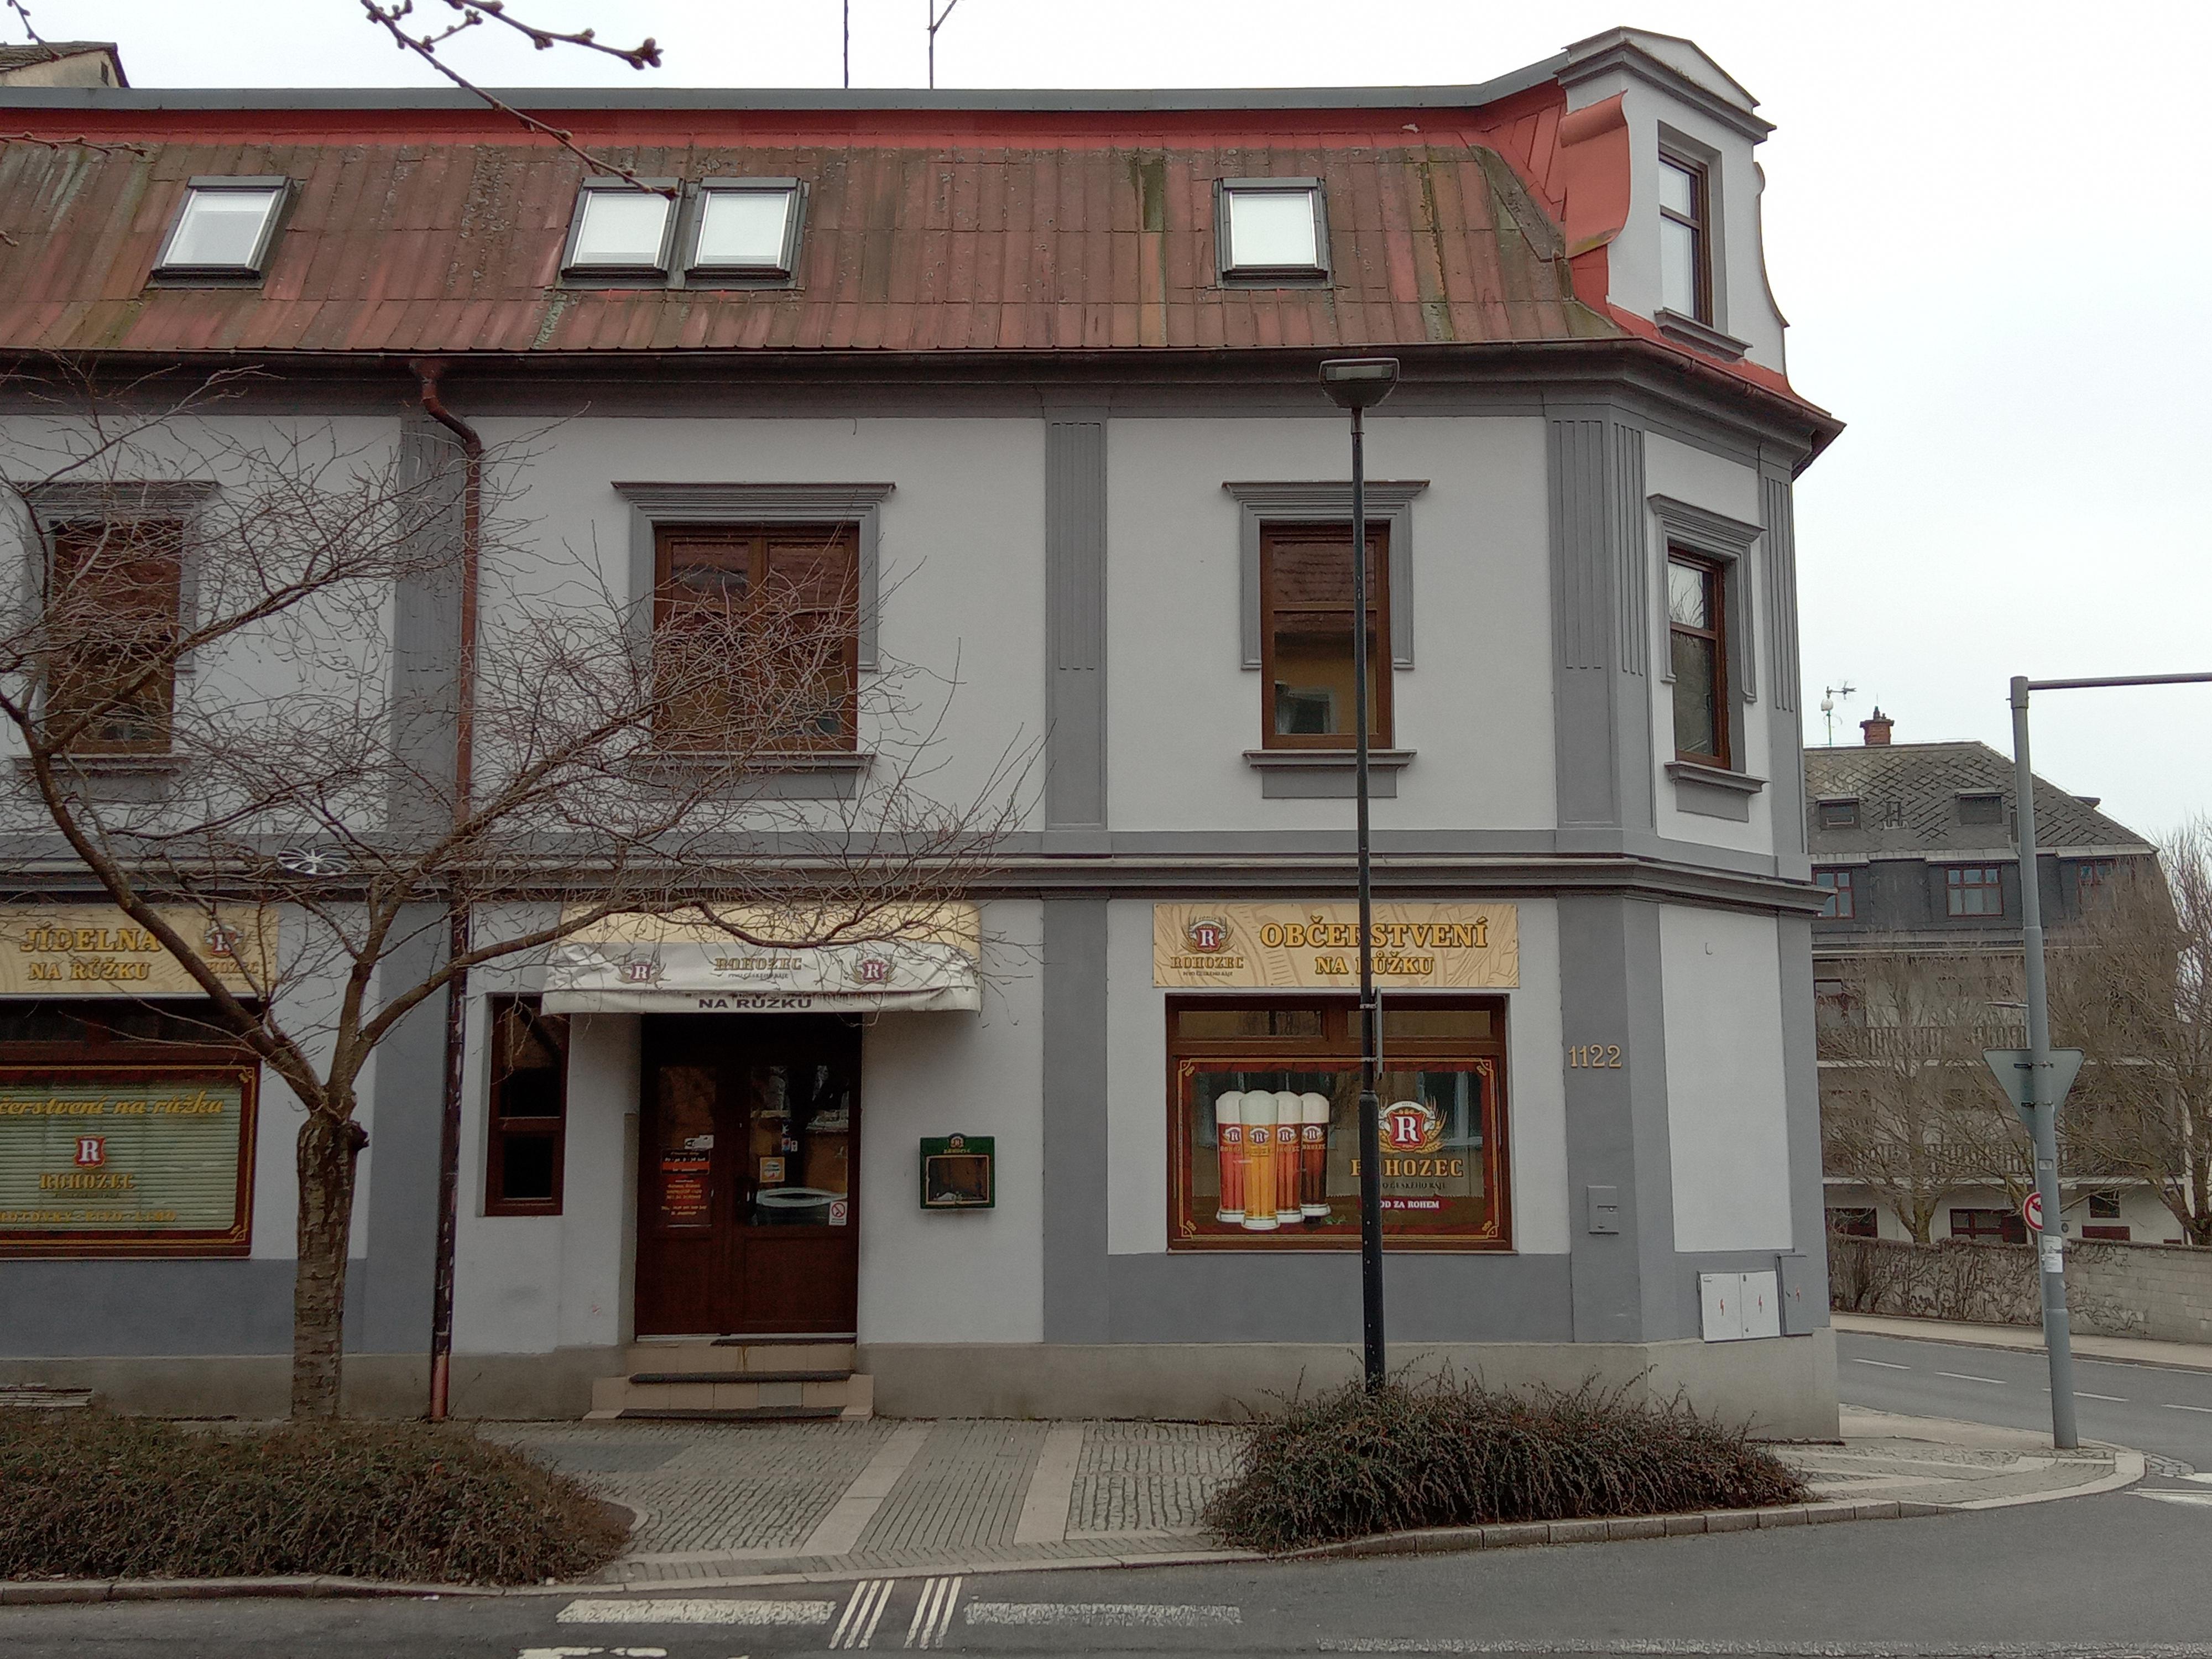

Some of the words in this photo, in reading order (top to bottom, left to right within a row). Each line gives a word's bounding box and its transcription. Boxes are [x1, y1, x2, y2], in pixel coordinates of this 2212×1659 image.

[20, 921, 161, 952] JÍDELNA
[1199, 930, 1215, 946] R
[28, 963, 62, 979] NA
[70, 956, 152, 979] RŮŽKU
[866, 964, 879, 978] R
[1170, 957, 1244, 969] ROHOZEC
[1315, 957, 1348, 974] NA
[1355, 951, 1434, 974] ŮŽKU
[633, 966, 647, 979] R
[699, 999, 728, 1008] NA
[1568, 1044, 1622, 1068] 1122
[113, 1100, 147, 1114] na
[152, 1090, 223, 1114] růžku
[1395, 1116, 1420, 1142] R
[79, 1140, 101, 1162] R
[1350, 1159, 1464, 1177] RHOZEC
[1408, 1201, 1439, 1209] ROHEM
